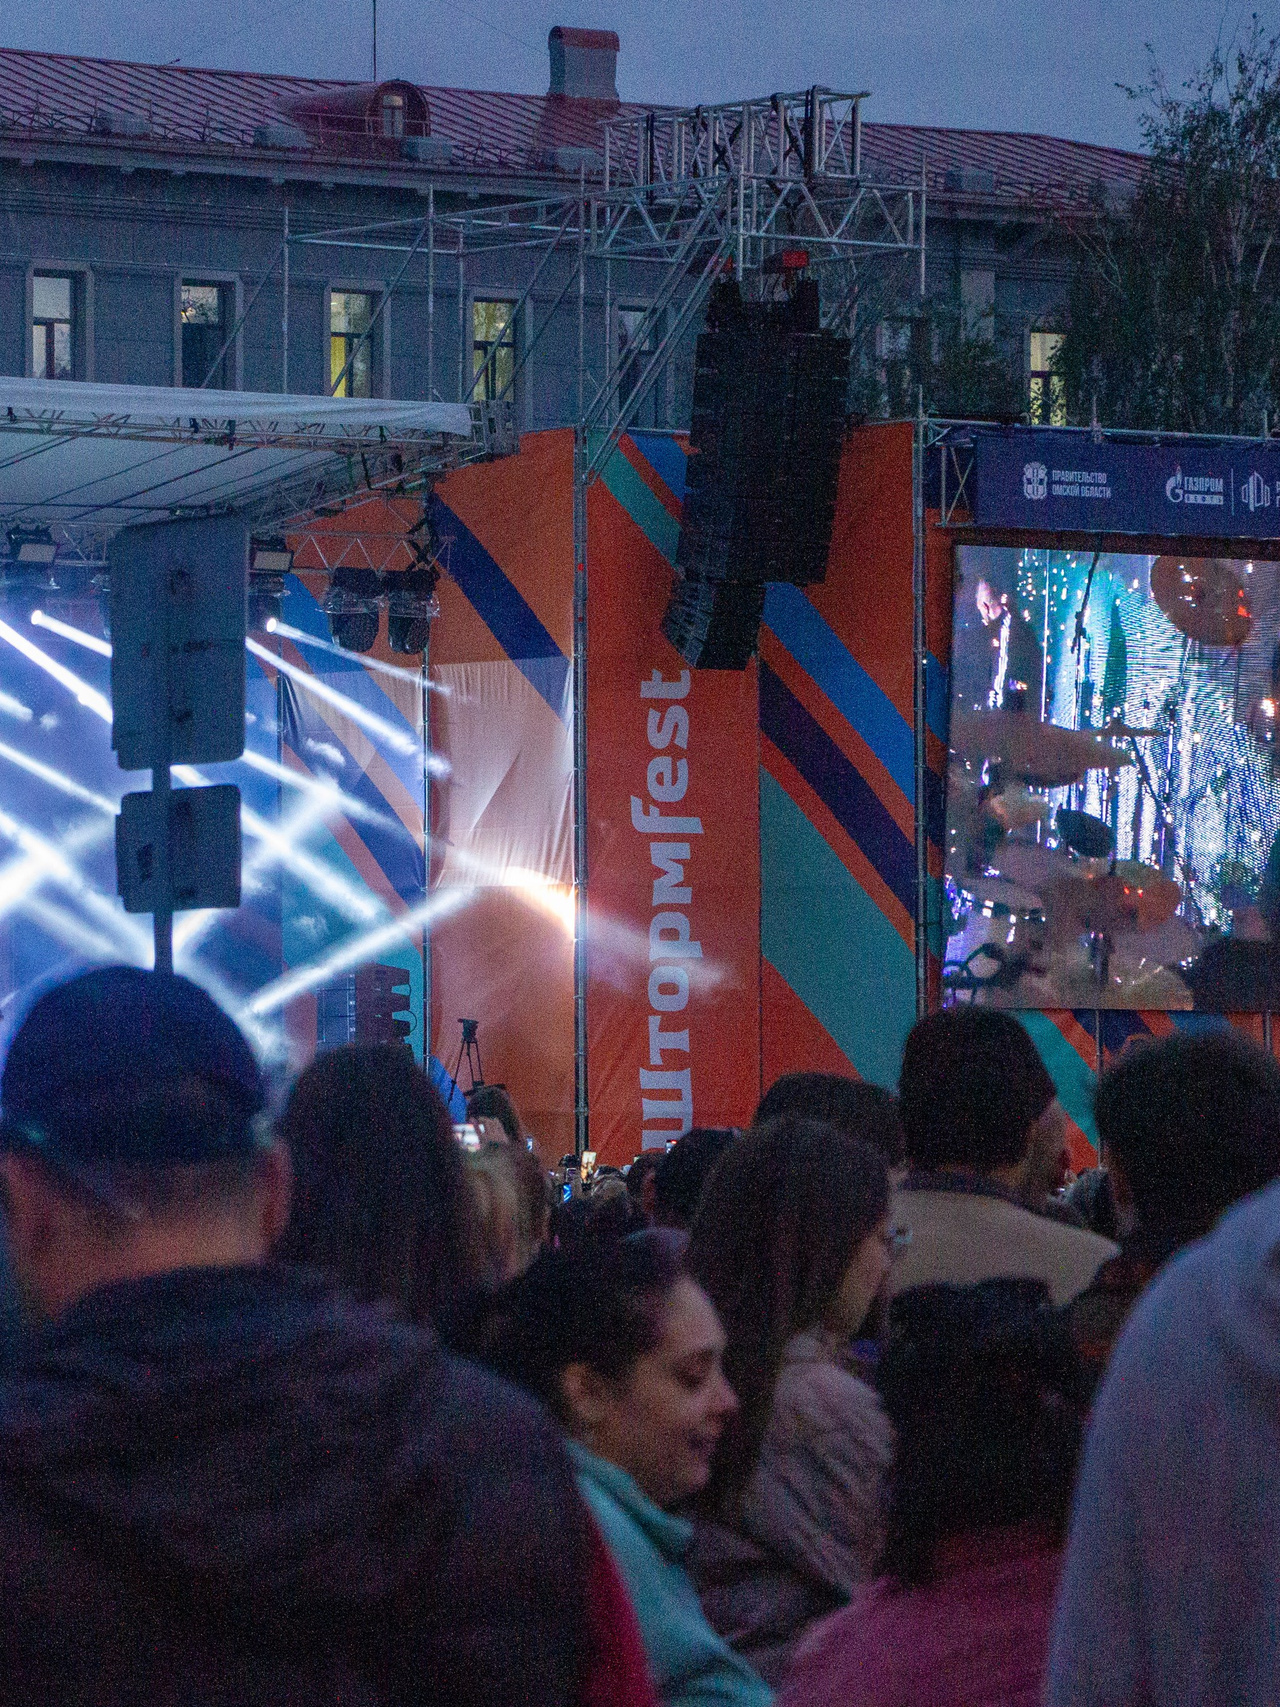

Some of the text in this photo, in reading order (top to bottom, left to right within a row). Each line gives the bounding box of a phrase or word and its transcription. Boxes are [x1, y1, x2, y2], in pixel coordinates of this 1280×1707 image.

[1052, 470, 1107, 484] ПРАВИТЕЛЬСТВО
[1184, 476, 1223, 492] ГАЗПРОМ
[1052, 484, 1112, 499] ОМСКОЙ ОБЛАСТИ
